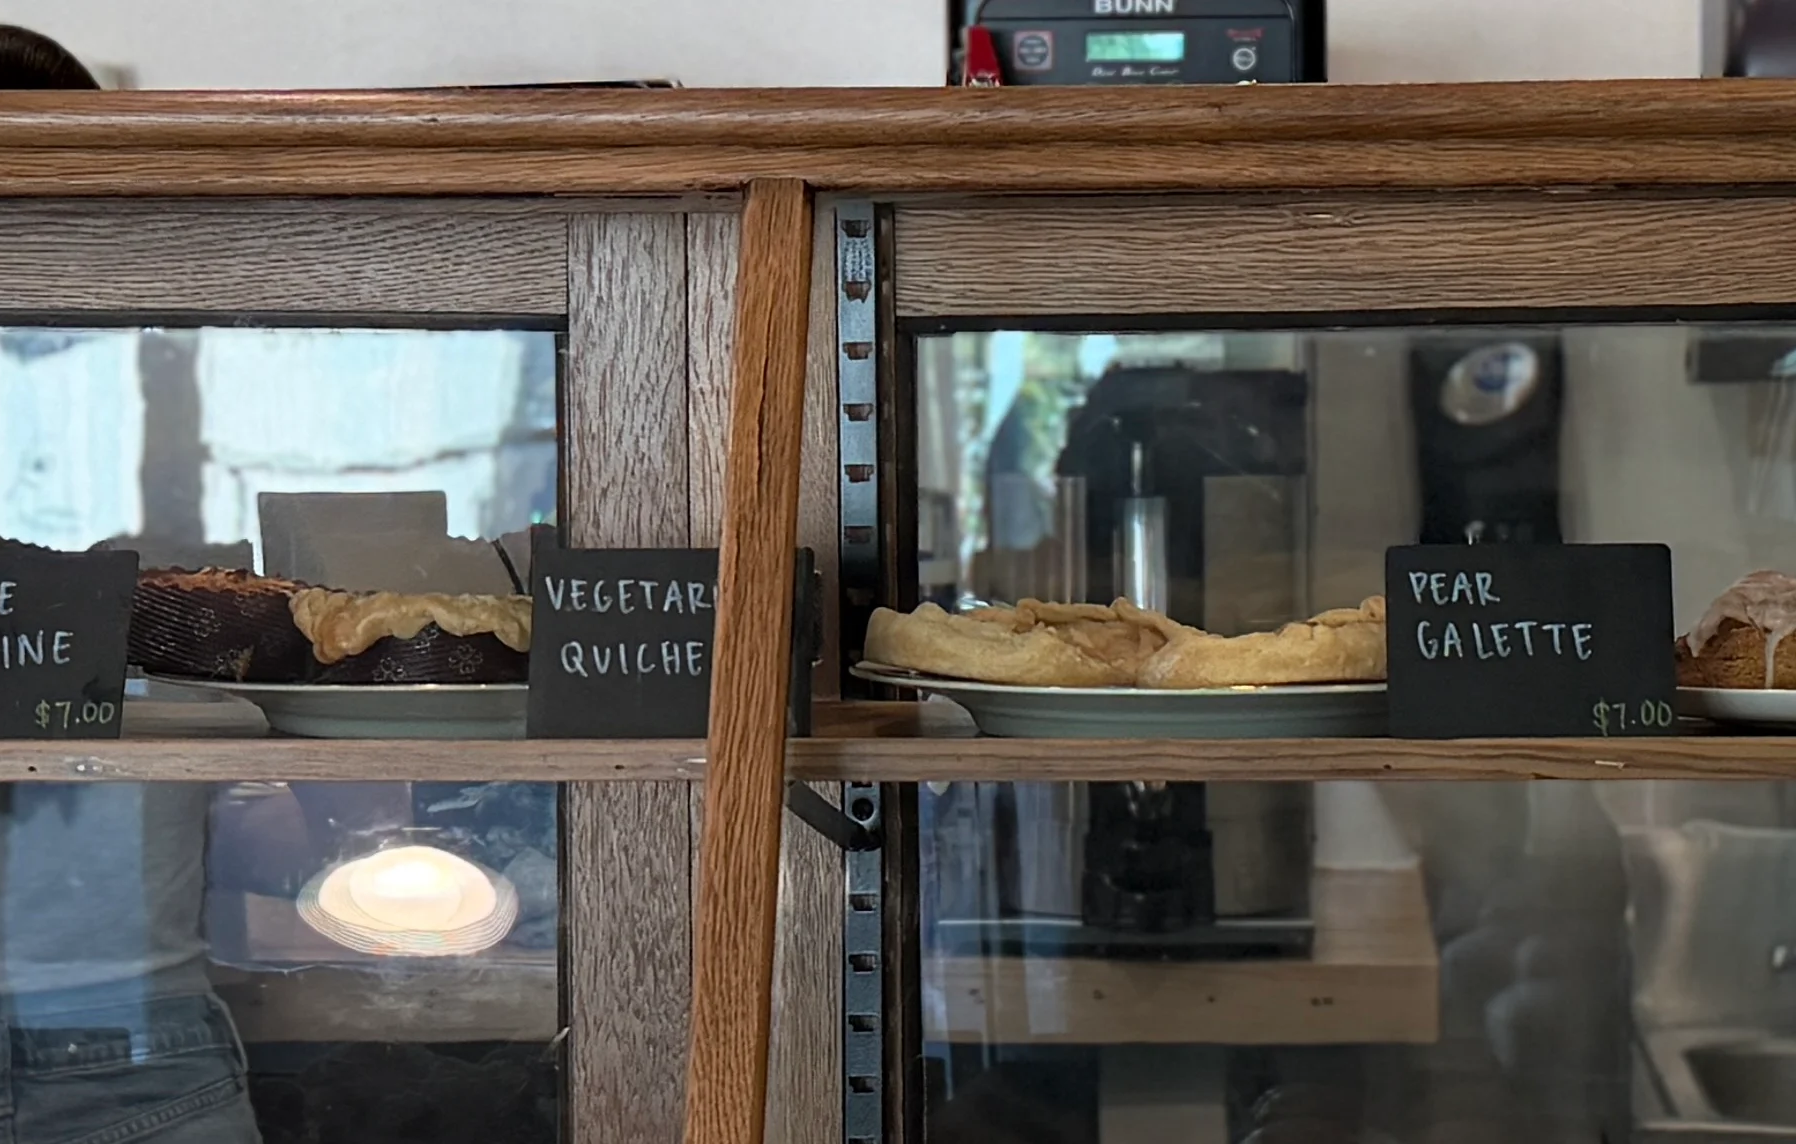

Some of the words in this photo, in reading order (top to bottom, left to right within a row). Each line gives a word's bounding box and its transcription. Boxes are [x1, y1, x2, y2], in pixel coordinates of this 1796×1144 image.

[1094, 0, 1174, 14] BUNN
[1409, 571, 1500, 606] PEAR
[1416, 620, 1593, 660] GALETTE
[560, 641, 704, 677] QUICHE
[35, 700, 115, 729] $7.00
[1592, 698, 1674, 736] $7.00
